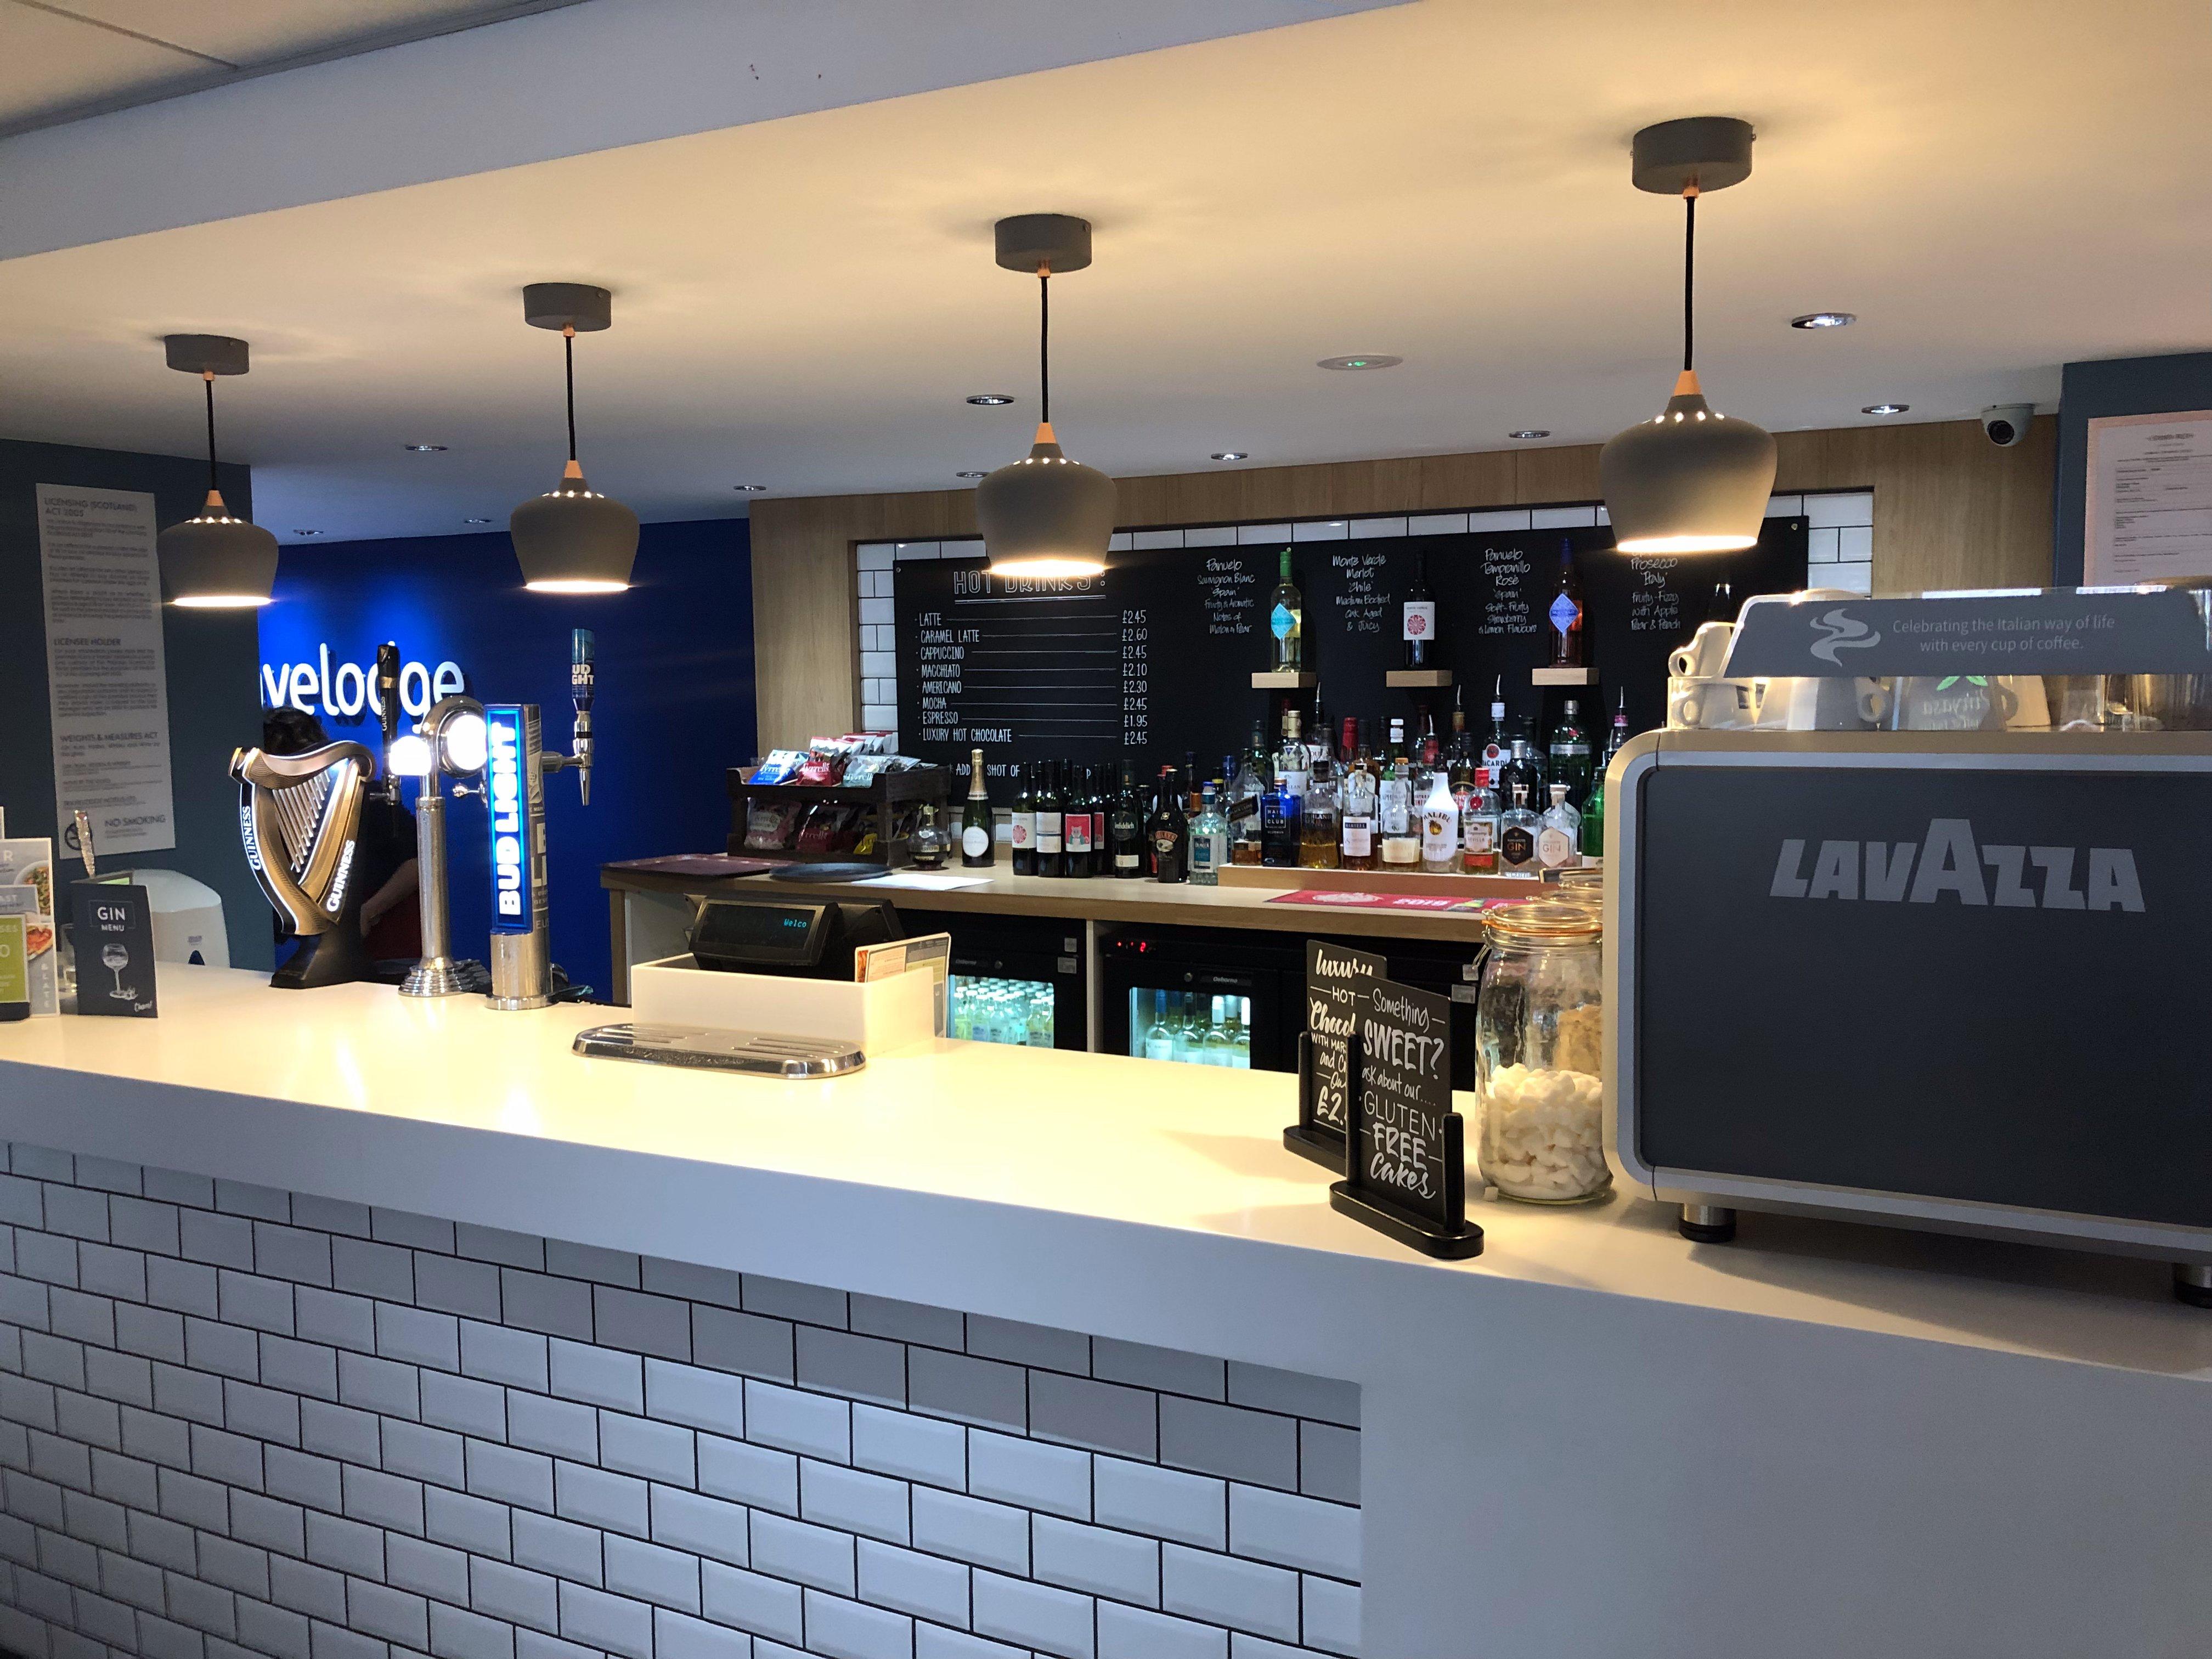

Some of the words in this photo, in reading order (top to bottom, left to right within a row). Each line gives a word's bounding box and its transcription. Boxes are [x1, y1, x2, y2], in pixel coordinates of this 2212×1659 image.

[1333, 554, 1359, 567] Monte
[1631, 557, 1678, 570] Prosecco
[1234, 572, 1255, 584] Blanc
[1346, 567, 1375, 579] Merlot
[954, 569, 991, 594] HOT
[919, 613, 941, 627] LATTE
[1214, 612, 1232, 622] Notes
[1233, 612, 1242, 622] of
[1893, 619, 1970, 635] Celebrating
[1972, 617, 1994, 631] the
[1998, 617, 2040, 631] Italian
[2044, 618, 2073, 633] way
[2076, 614, 2090, 629] of
[2093, 614, 2115, 629] life
[921, 630, 954, 644] CARAMEL
[958, 629, 980, 642] LATTE
[1122, 628, 1148, 641] £2.60
[1920, 637, 1949, 652] with
[1952, 639, 1988, 654] every
[1991, 639, 2017, 654] cup
[2020, 636, 2034, 651] of
[2037, 635, 2084, 650] coffee.
[921, 646, 964, 660] CAPPUCCINO
[572, 664, 591, 674] UD
[921, 663, 961, 678] MACCHIATO
[1122, 663, 1148, 676] £2.10
[572, 674, 594, 685] GHT
[922, 680, 962, 694] AMERICANO
[922, 697, 947, 709] MOCHA
[923, 711, 958, 725] ESPRESSO
[1124, 714, 1148, 727] £1.95
[923, 728, 949, 742] LUXURY
[953, 728, 967, 742] HOT
[971, 728, 1012, 743] CHOCOLATE
[491, 721, 520, 833] LIGHT
[956, 764, 970, 776] ADD
[987, 764, 1007, 777] SHOT
[1010, 765, 1020, 777] OF
[242, 805, 262, 872] GUINNESS
[1506, 842, 1527, 852] GIN
[1542, 843, 1561, 853] GIN
[1769, 818, 2147, 913] LAVAZZA
[326, 839, 356, 912] GUINNESS
[496, 838, 521, 916] BUD
[97, 906, 126, 922] GIN
[101, 924, 125, 932] MENU
[783, 918, 807, 930] Welco
[1331, 986, 1356, 1007] HOT
[1373, 988, 1430, 1034] Something
[1311, 1032, 1329, 1048] WITH
[1363, 1018, 1445, 1080] SWEET?
[1319, 1051, 1336, 1069] and
[1362, 1065, 1376, 1087] ask
[1378, 1069, 1403, 1093] about
[1364, 1090, 1436, 1142] GLUTEN
[1373, 1121, 1427, 1171] FREE
[1370, 1152, 1436, 1199] Cakes
